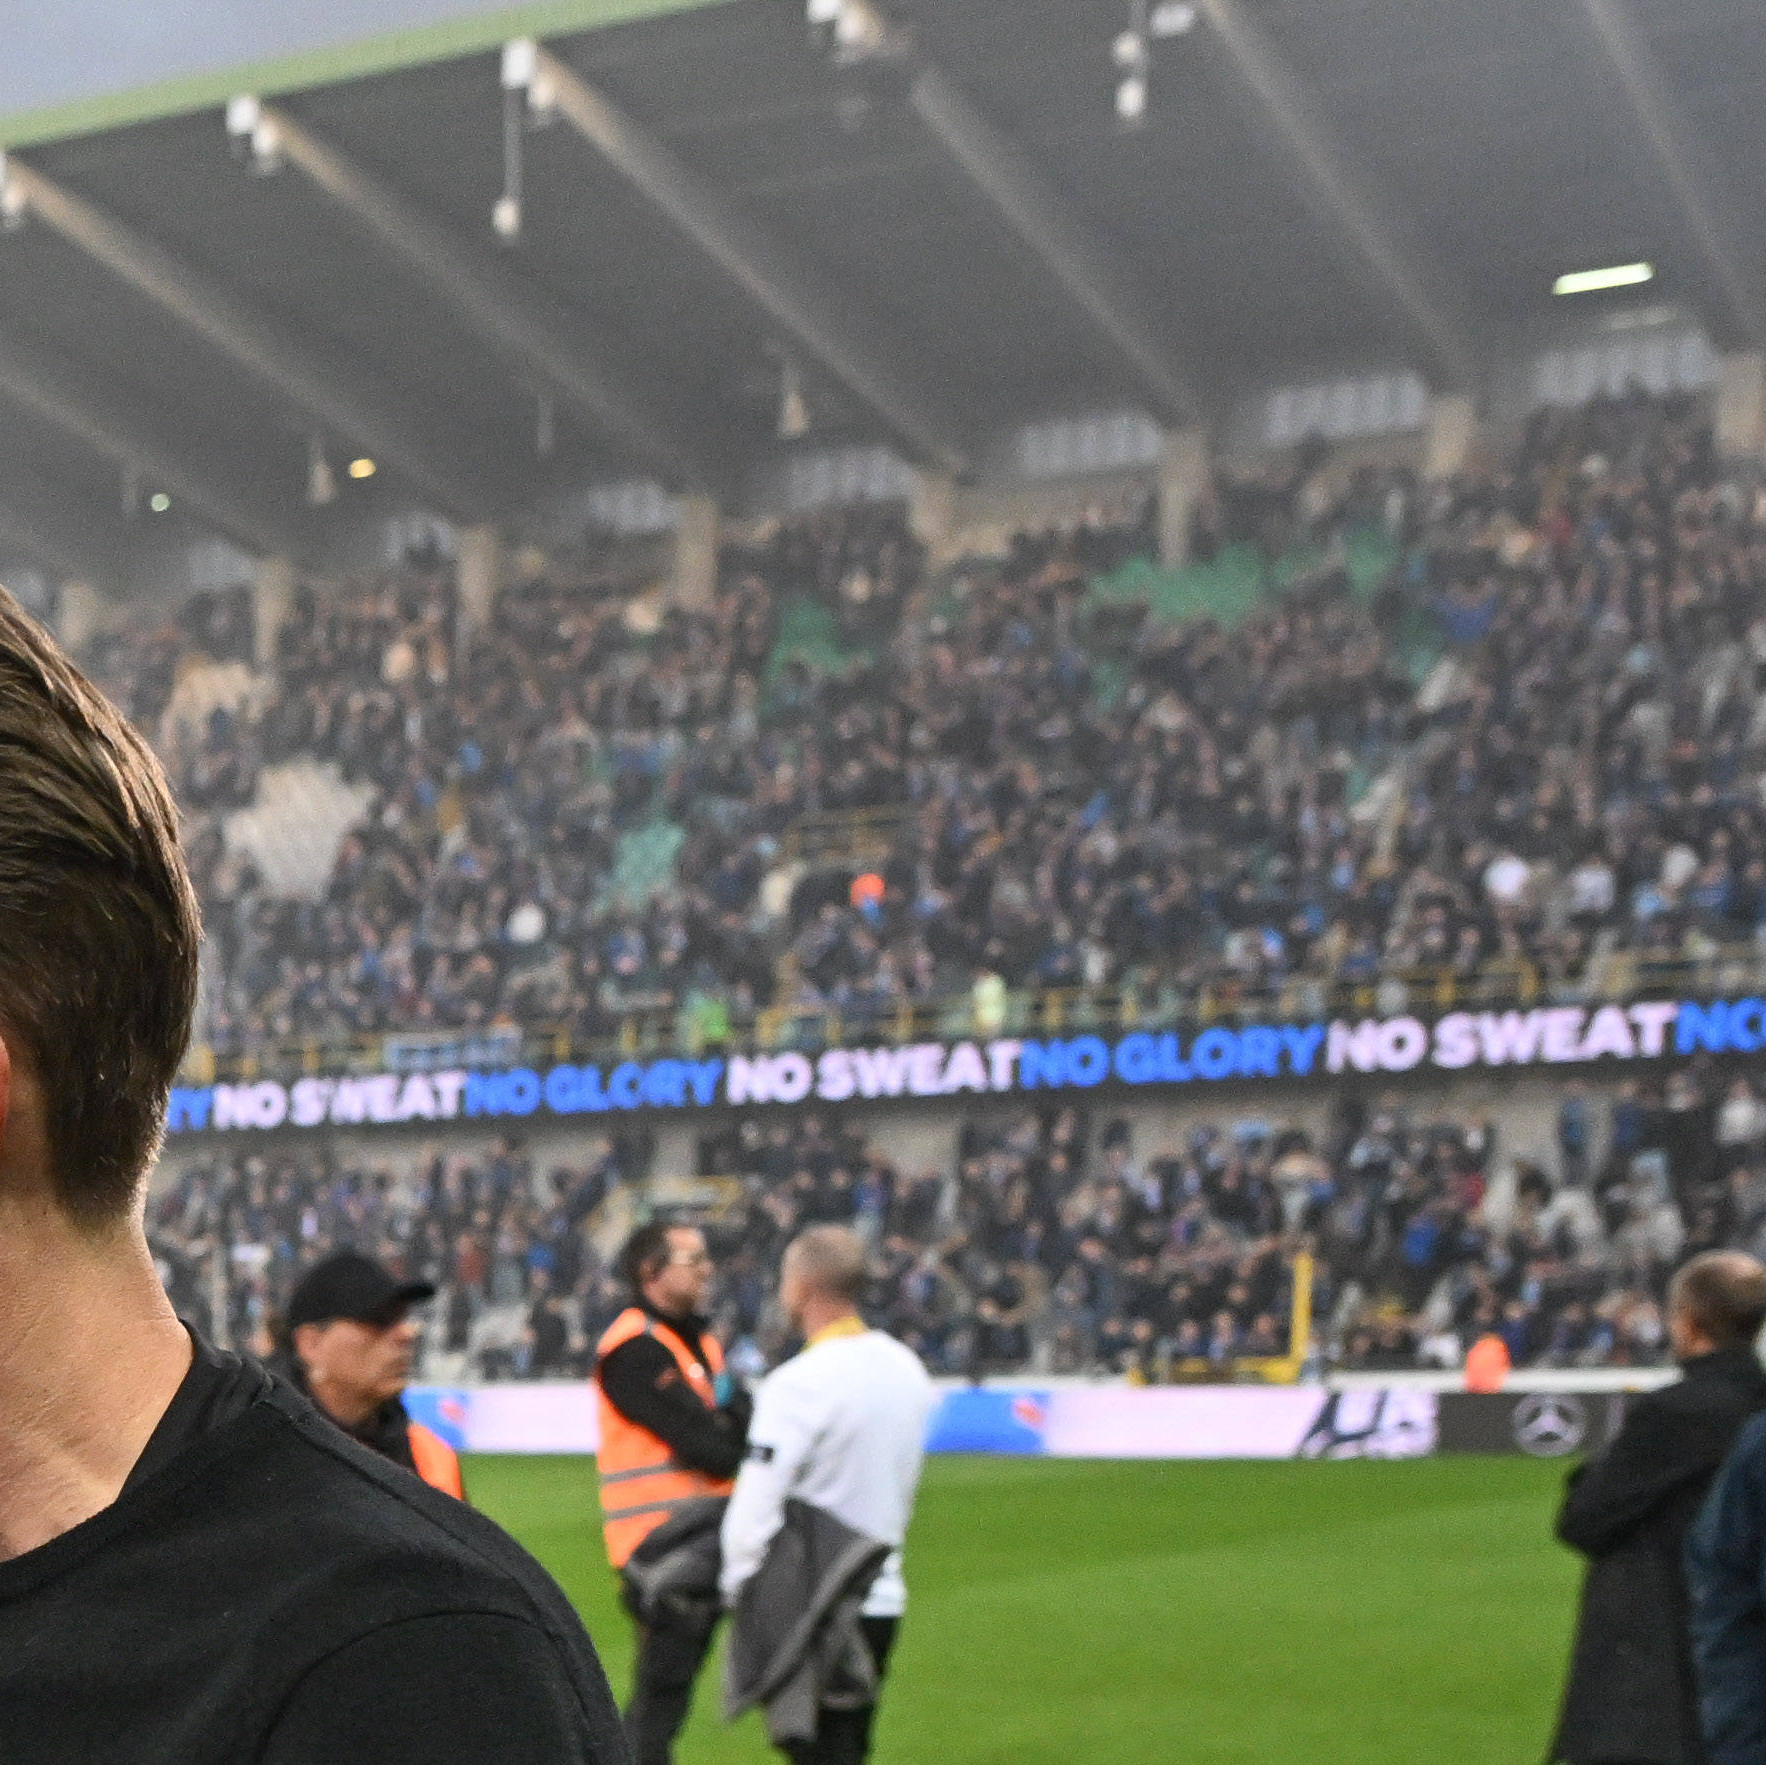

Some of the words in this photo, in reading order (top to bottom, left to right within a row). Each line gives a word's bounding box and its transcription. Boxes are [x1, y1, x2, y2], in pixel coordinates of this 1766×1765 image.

[213, 1080, 287, 1129] NO
[290, 1073, 466, 1126] SWEAT
[463, 1068, 540, 1117] NO
[544, 1059, 723, 1115] GLORY
[726, 1053, 813, 1104] NO
[816, 1040, 1020, 1100] SWEAT
[1016, 1035, 1110, 1088] NO
[1115, 1025, 1326, 1084] GLORY
[1326, 1016, 1427, 1074] NO
[1432, 1003, 1679, 1069] SWEAT
